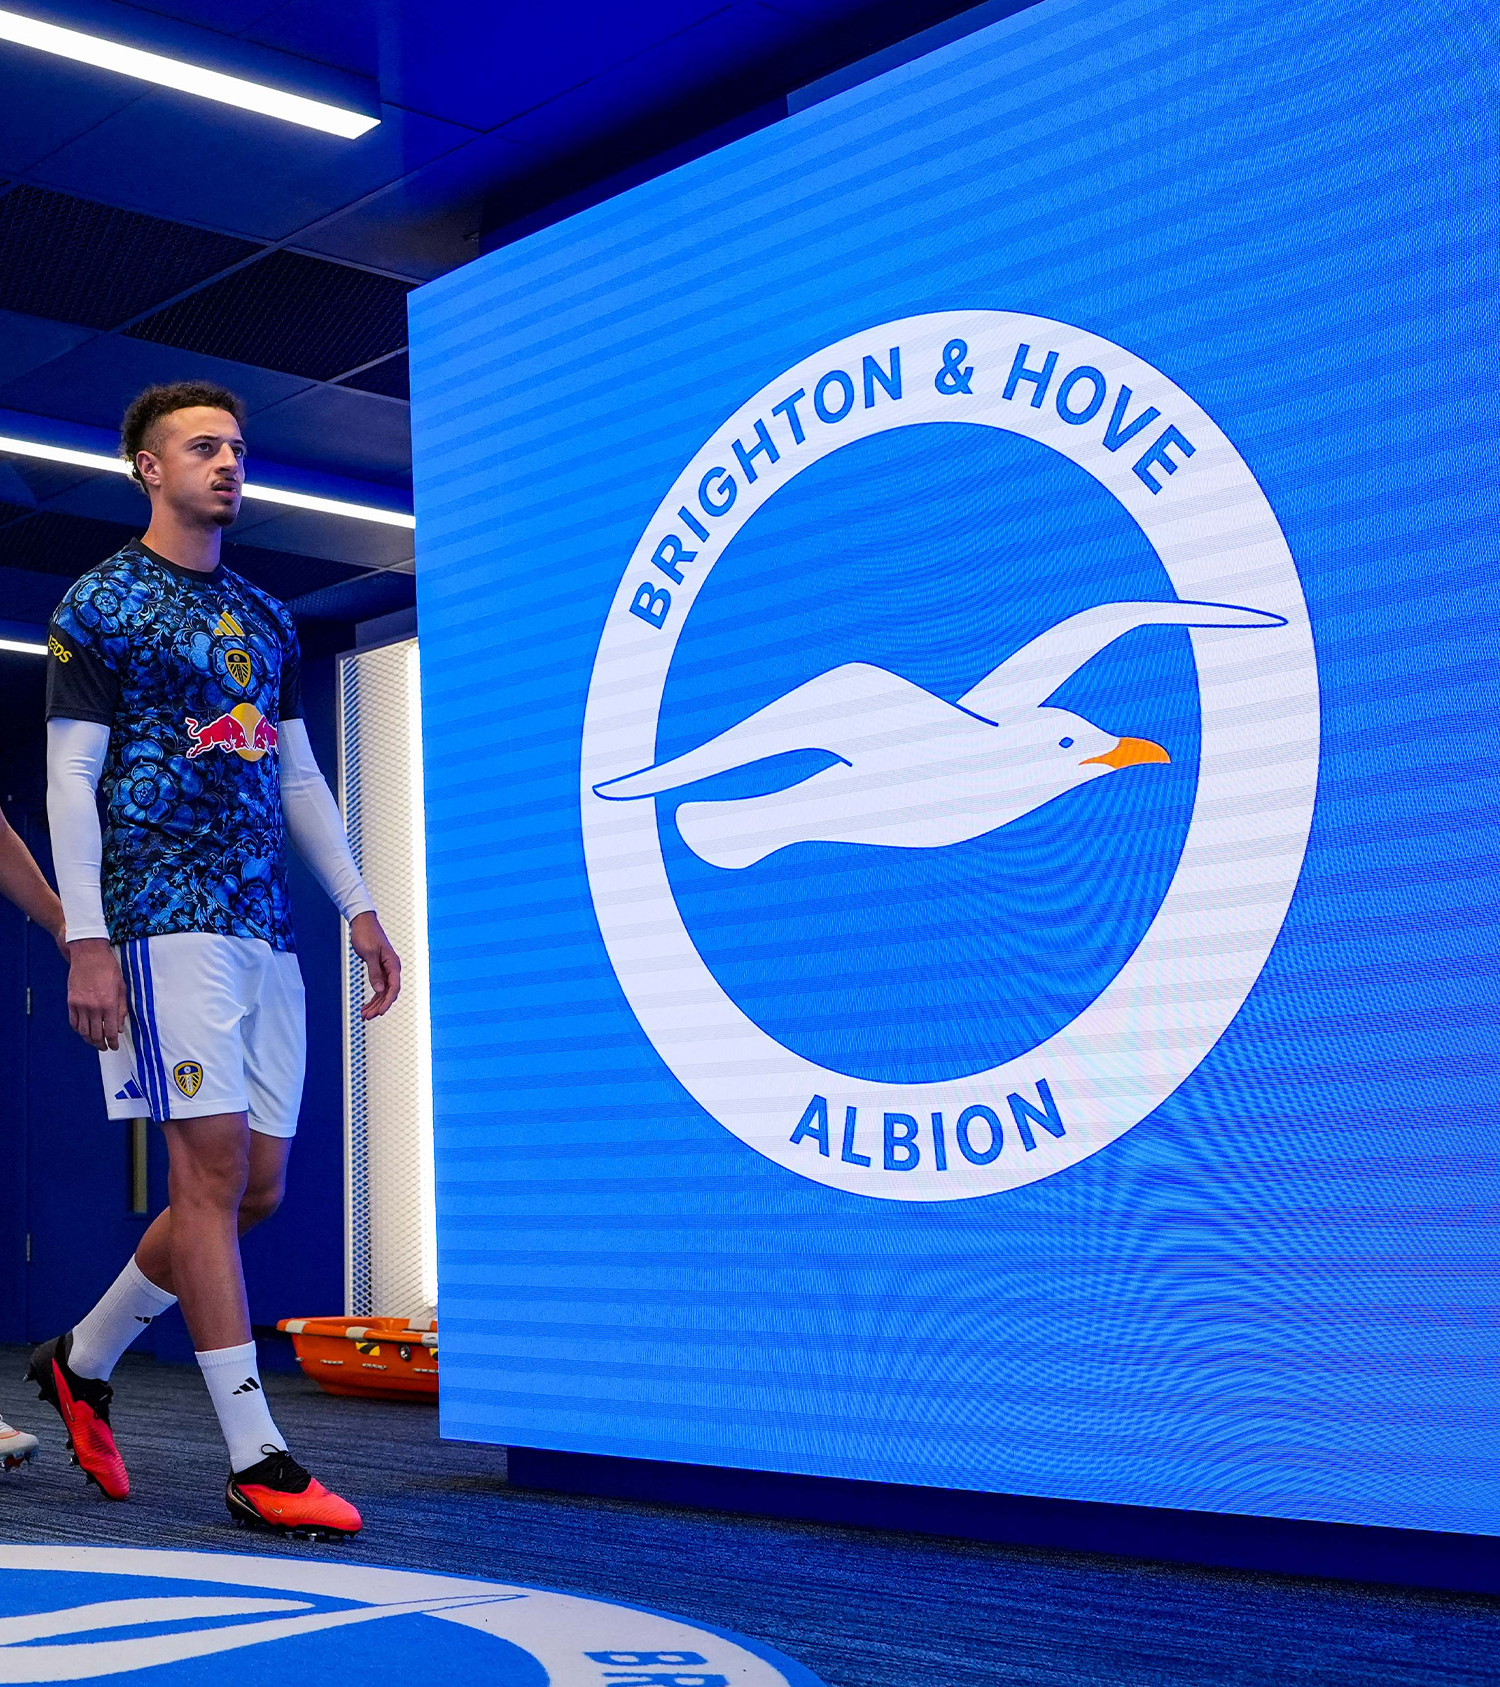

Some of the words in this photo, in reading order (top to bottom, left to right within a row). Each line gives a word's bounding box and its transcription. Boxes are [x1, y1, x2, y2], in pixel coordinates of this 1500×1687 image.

[628, 346, 903, 630] BRIGHTON
[934, 338, 974, 396] &
[1001, 342, 1197, 496] HOVE
[789, 1077, 1067, 1173] ALBION
